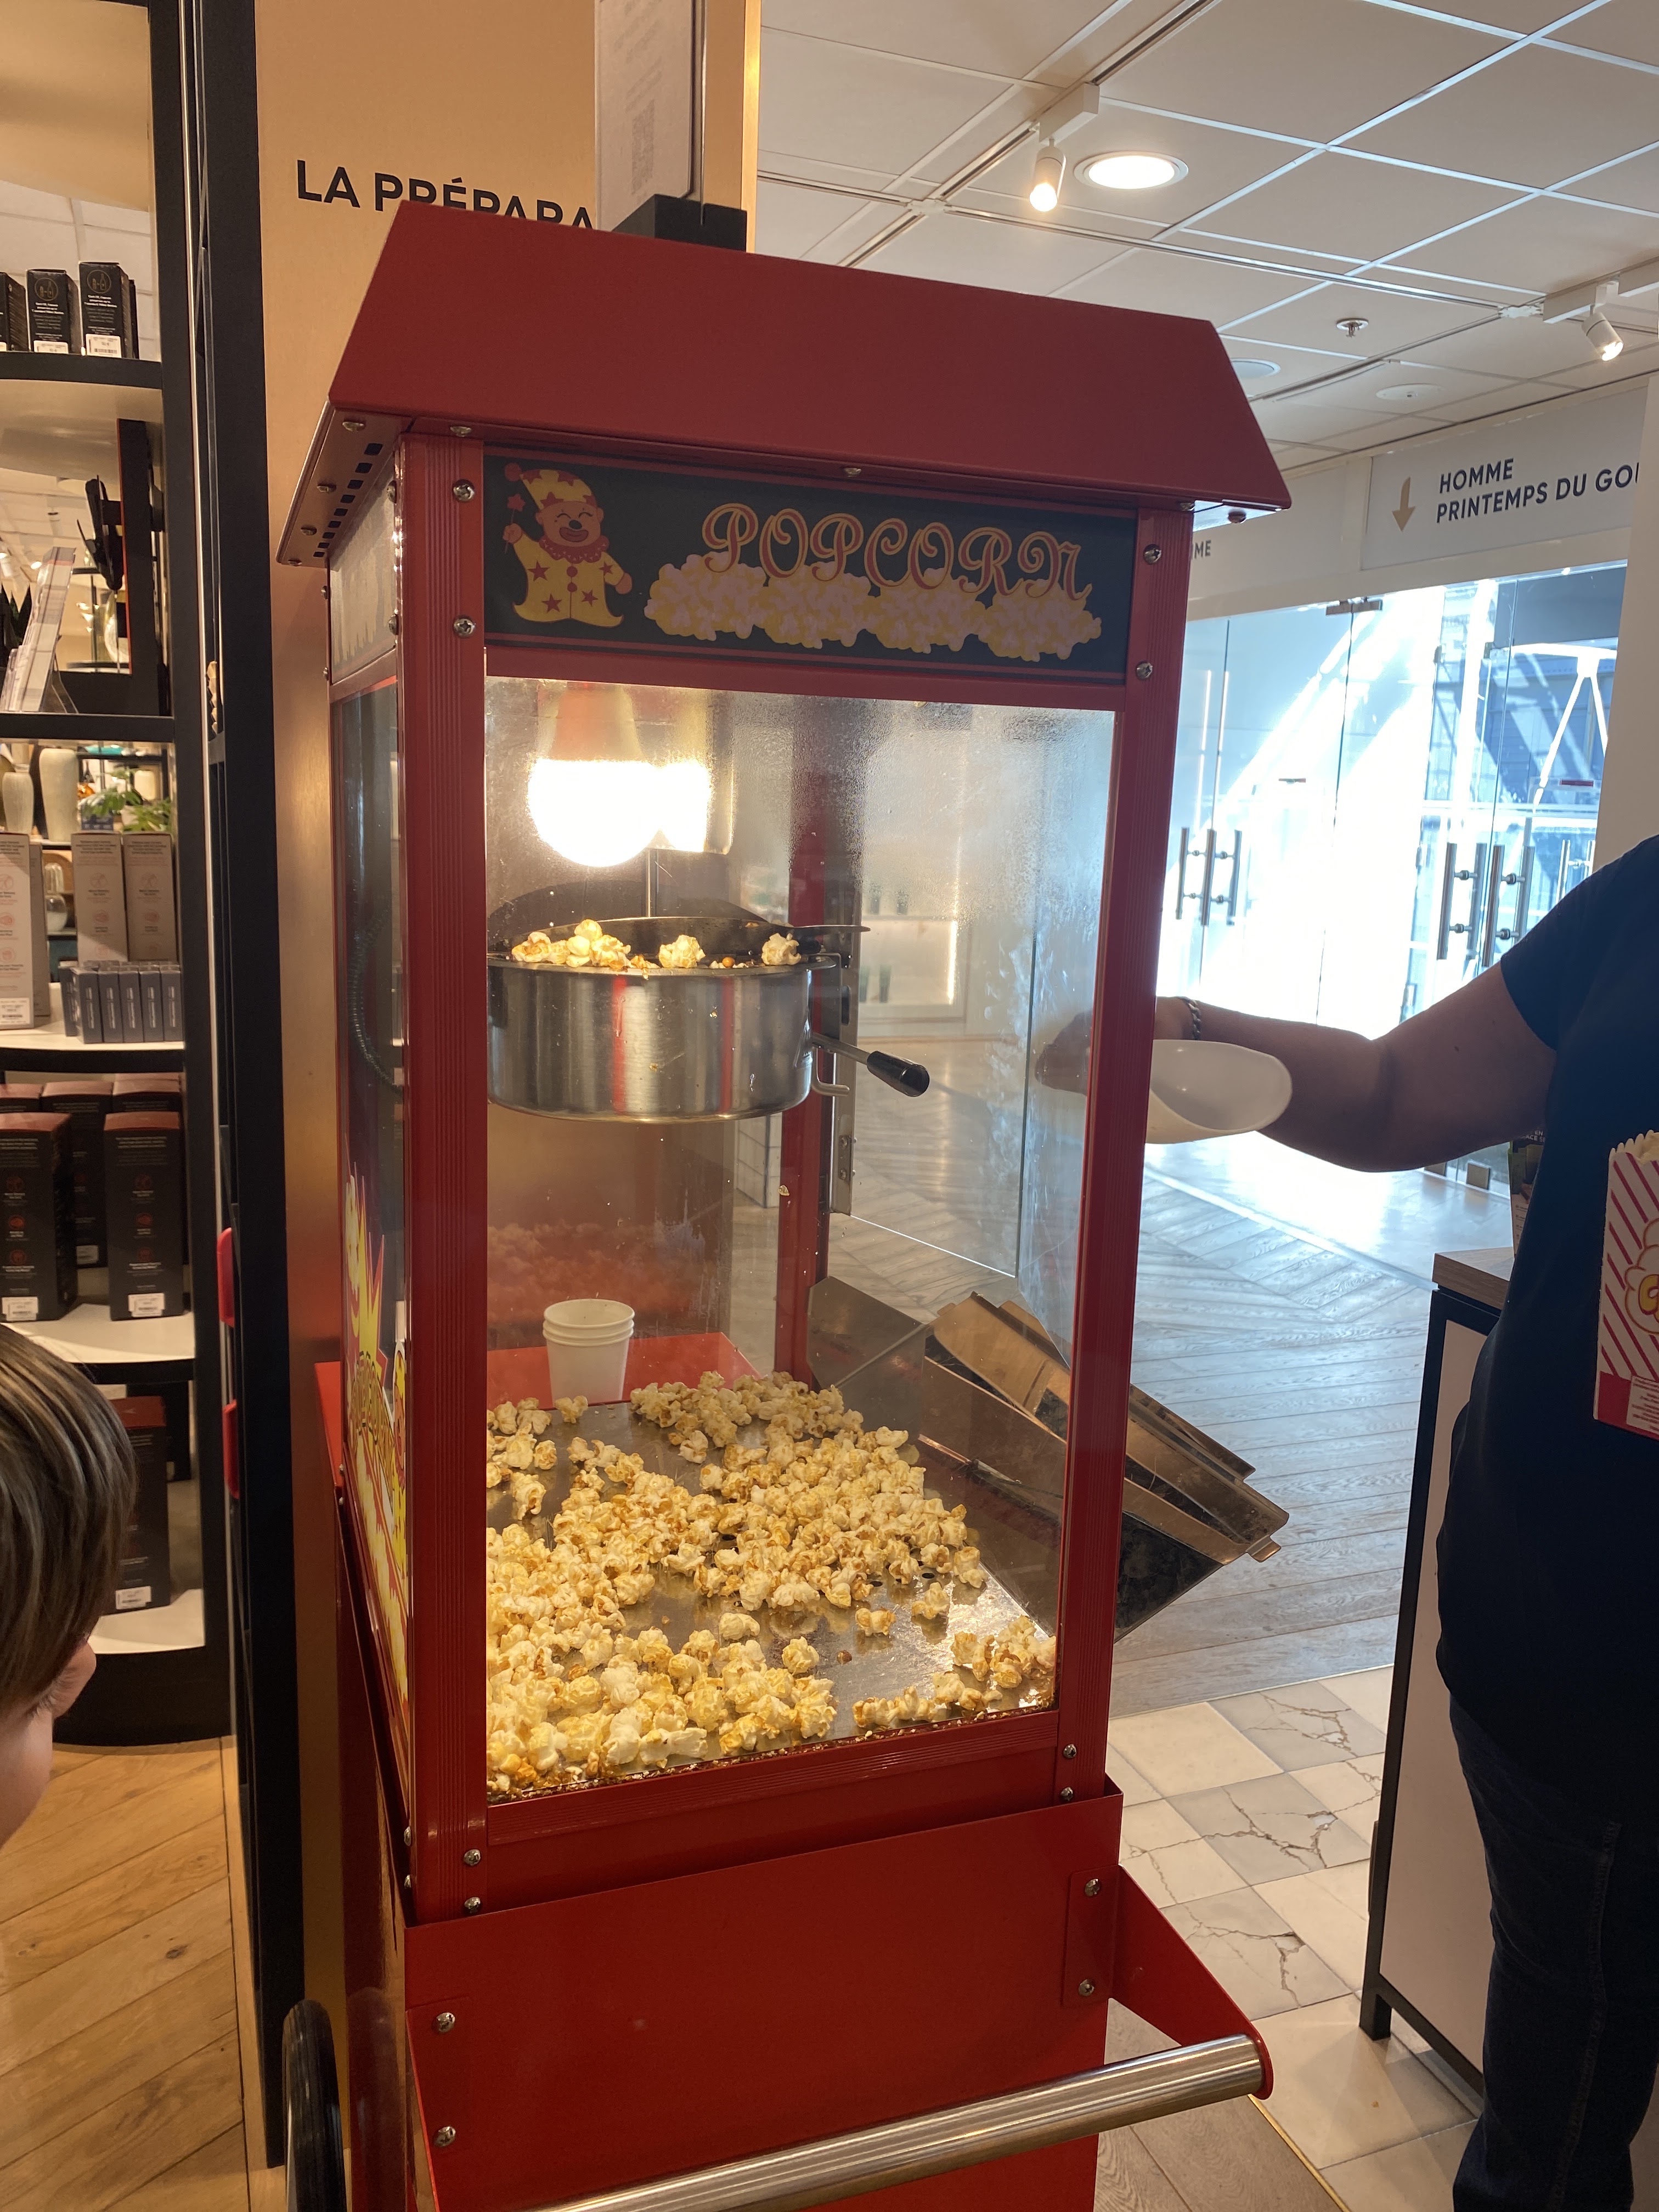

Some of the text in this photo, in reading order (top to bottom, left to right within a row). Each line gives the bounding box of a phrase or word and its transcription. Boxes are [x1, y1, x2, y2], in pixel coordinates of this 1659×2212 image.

[297, 160, 360, 208] LA
[1437, 462, 1639, 523] PRINTEMPS DU GO
[1440, 458, 1514, 493] HOMME
[703, 503, 1092, 601] POPCORN
[1191, 540, 1211, 559] ME
